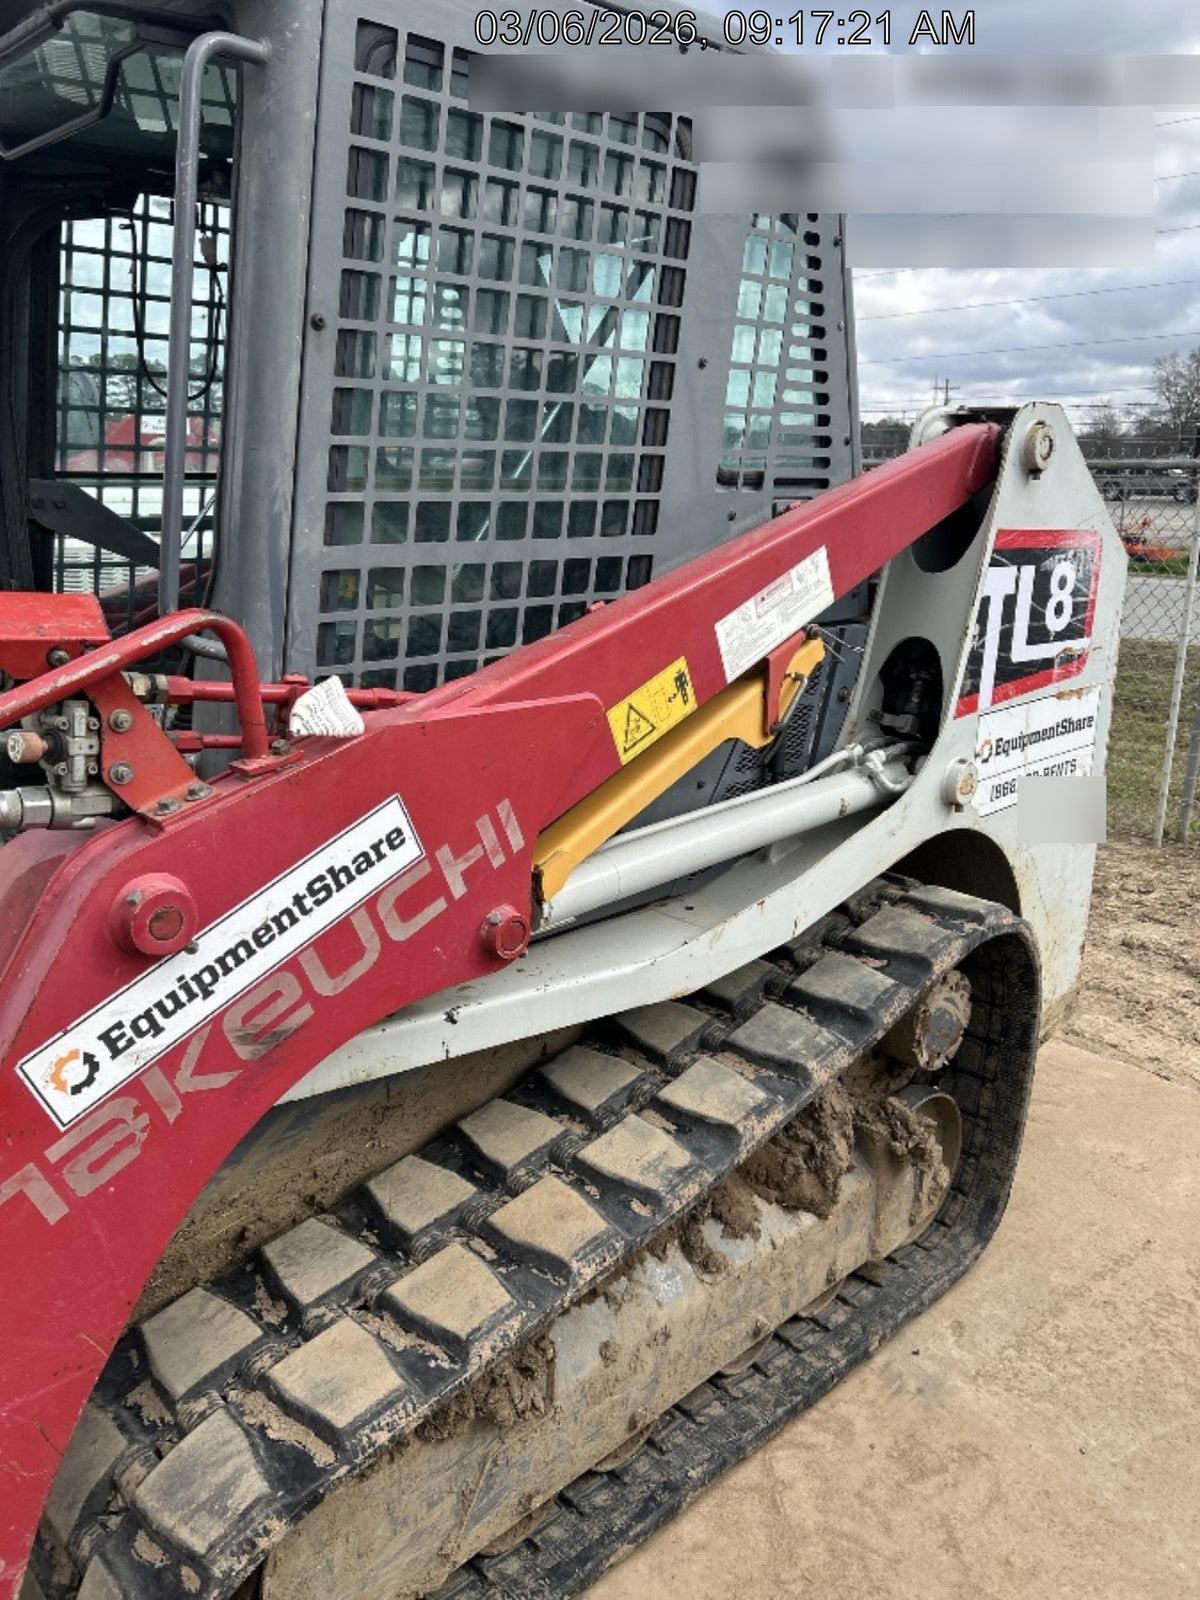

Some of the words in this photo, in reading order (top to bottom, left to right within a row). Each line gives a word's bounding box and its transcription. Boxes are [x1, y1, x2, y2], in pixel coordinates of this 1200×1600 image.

[977, 561, 1091, 709] TL8
[994, 716, 1095, 757] EquipmentShare
[97, 826, 407, 1061] EquipmentShare
